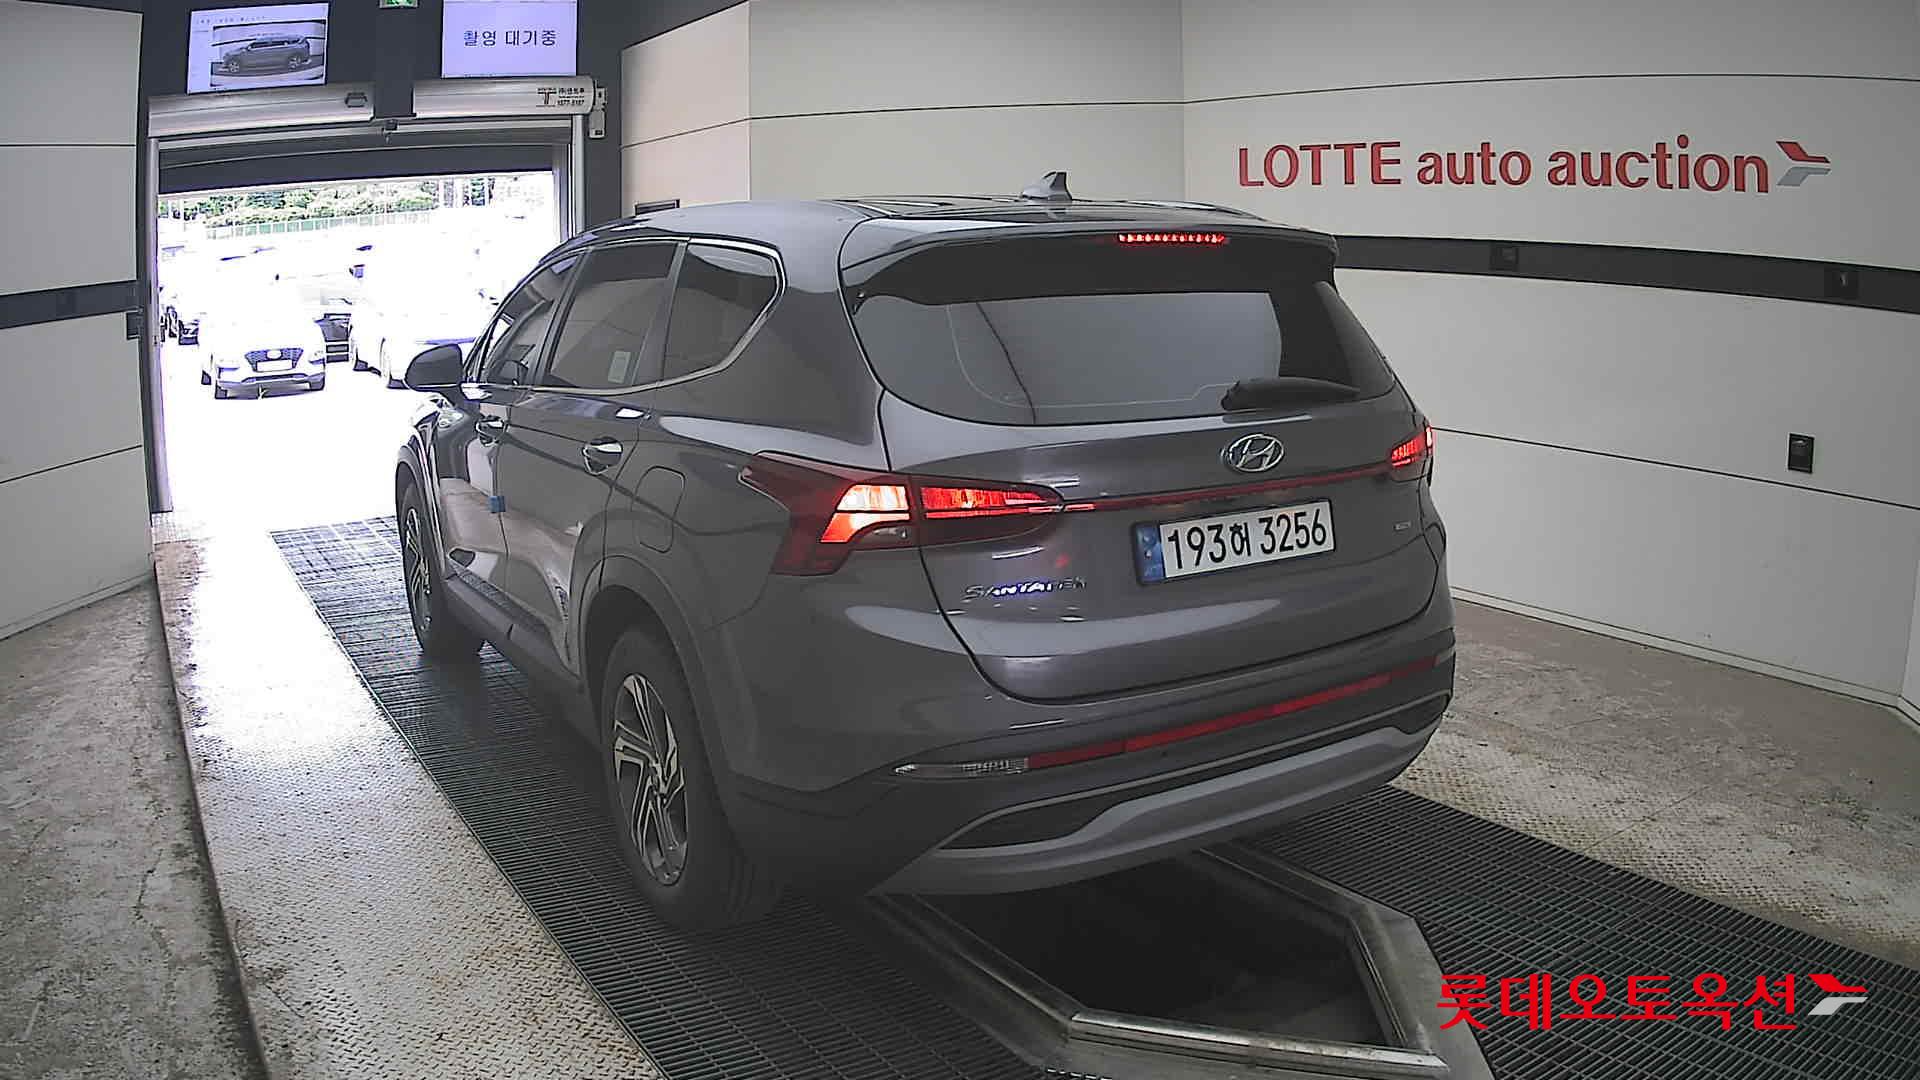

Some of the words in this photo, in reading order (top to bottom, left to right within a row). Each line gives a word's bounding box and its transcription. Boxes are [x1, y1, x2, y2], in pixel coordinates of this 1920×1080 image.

[505, 29, 557, 47] 대기중
[1239, 140, 1401, 188] LOTTE
[1416, 141, 1532, 187] auto
[1546, 133, 1770, 194] auction
[1166, 521, 1251, 570] 193허
[1258, 507, 1328, 555] 3256
